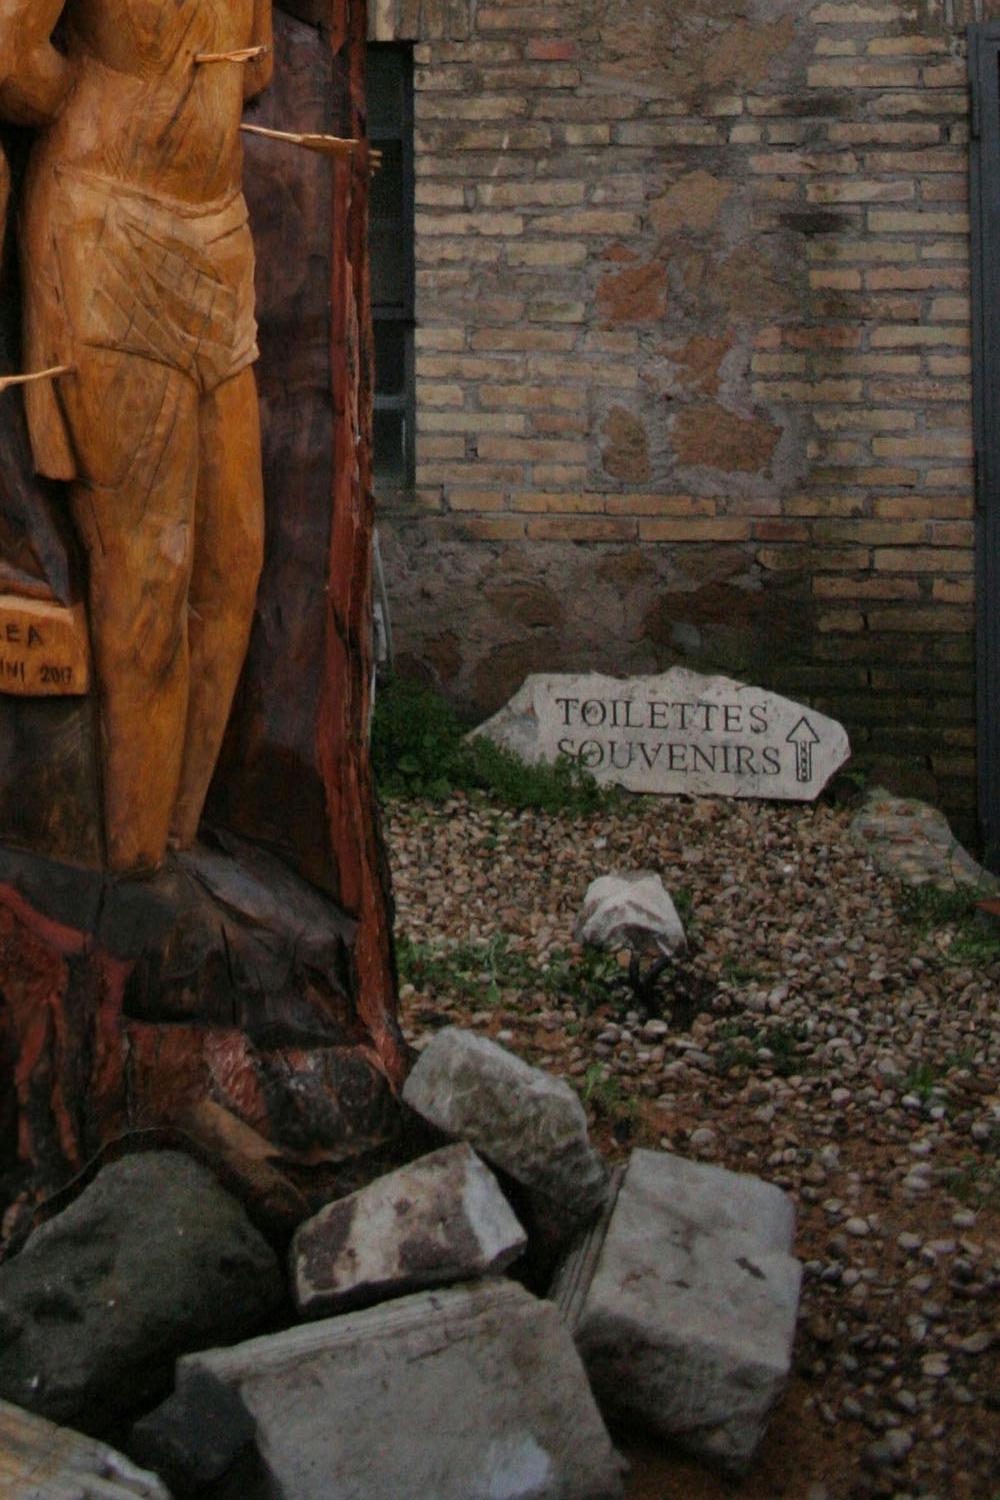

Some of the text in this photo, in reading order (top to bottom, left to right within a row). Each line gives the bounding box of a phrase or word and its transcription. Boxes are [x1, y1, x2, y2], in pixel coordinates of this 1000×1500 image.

[40, 664, 73, 685] 2017
[555, 697, 769, 734] TOILETTES
[556, 738, 782, 776] SOUVENIRS
